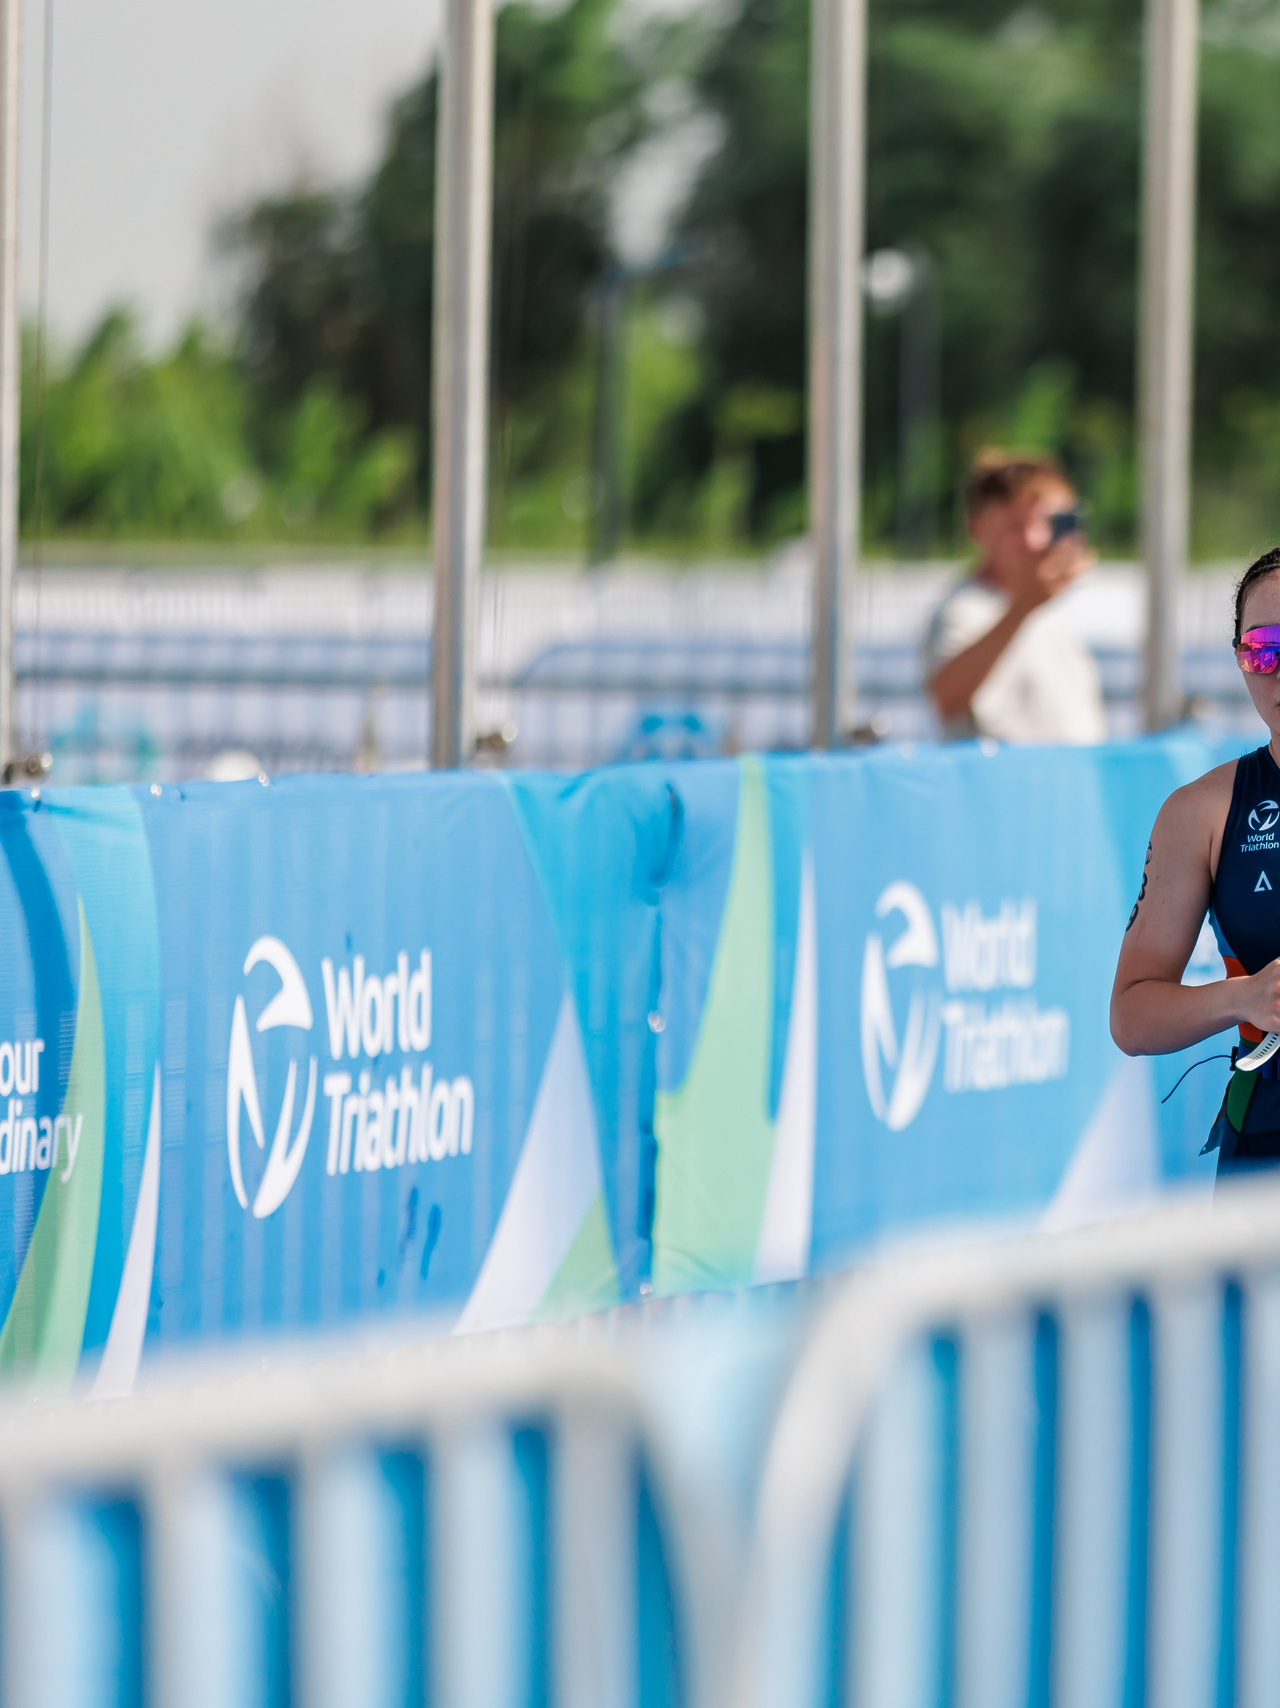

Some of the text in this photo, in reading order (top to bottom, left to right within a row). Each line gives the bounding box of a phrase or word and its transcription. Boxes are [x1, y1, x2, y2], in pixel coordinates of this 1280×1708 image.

[1240, 841, 1280, 853] Triathlon
[1247, 832, 1275, 843] World
[321, 946, 433, 1060] World
[323, 1061, 475, 1177] Triathlon
